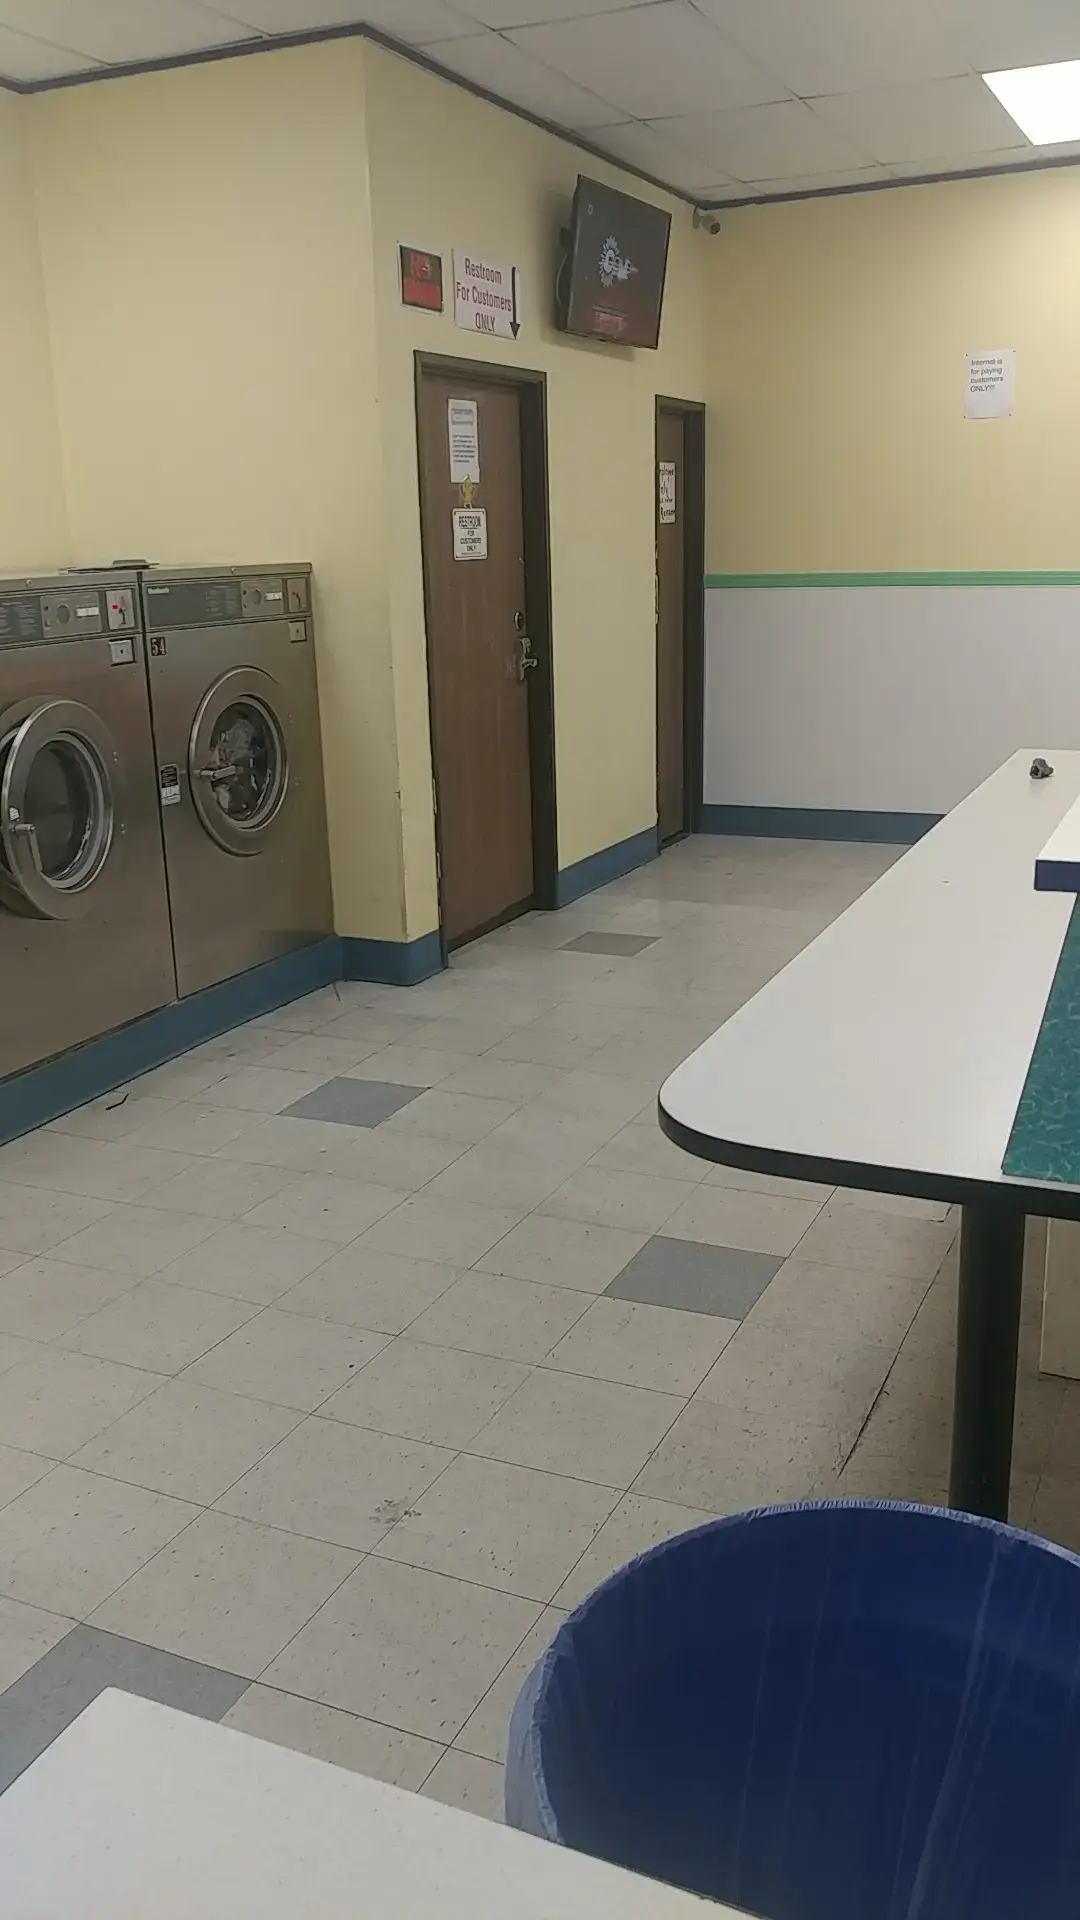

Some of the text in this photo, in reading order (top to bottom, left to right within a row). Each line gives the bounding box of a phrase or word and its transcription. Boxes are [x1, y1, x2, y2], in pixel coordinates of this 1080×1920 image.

[464, 257, 502, 285] Restroom
[456, 281, 512, 312] For Customers
[475, 312, 496, 332] ONLY
[971, 358, 996, 366] Internet
[980, 367, 1003, 376] paying
[970, 376, 1004, 384] customers
[460, 537, 482, 545] CUSTOMERS
